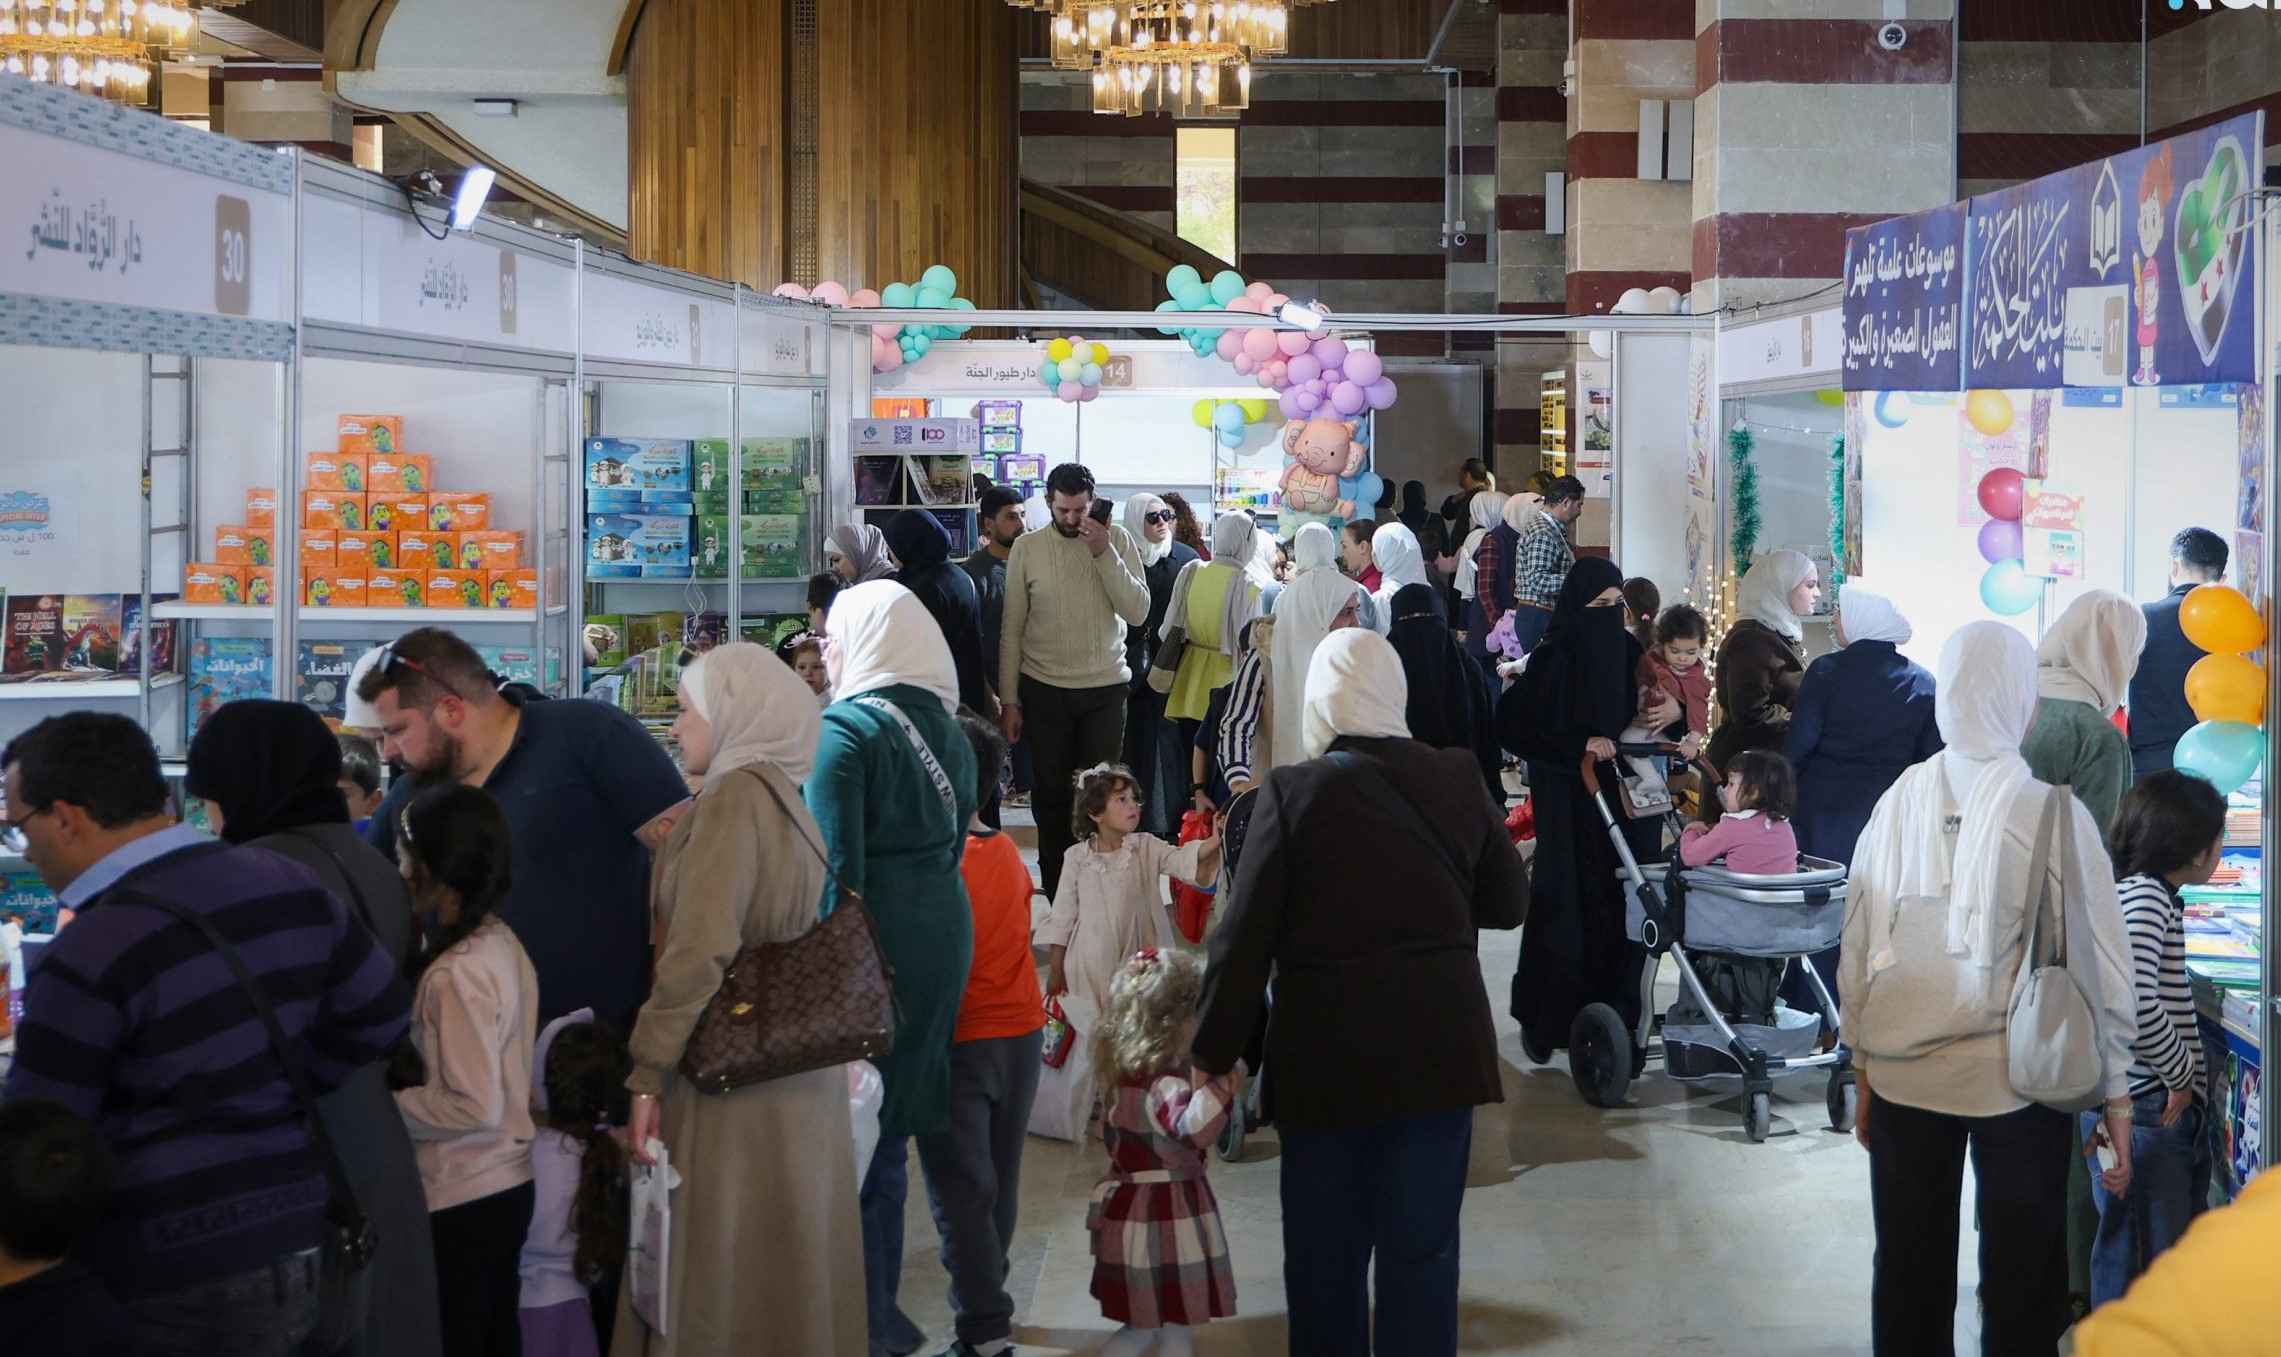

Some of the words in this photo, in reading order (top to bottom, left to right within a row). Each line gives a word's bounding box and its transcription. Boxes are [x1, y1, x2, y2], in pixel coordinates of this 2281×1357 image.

[119, 219, 142, 275] دار
[222, 229, 244, 283] 30
[1849, 243, 1876, 297] تلهم
[1876, 237, 1902, 297] علمية
[1904, 232, 1956, 291] موسوعات
[502, 274, 513, 311] 30
[1841, 310, 1878, 371] والكبيرة
[1880, 307, 1920, 369] الصغيرة
[1921, 303, 1957, 368] العقول
[2109, 318, 2120, 354] 17
[993, 366, 1020, 381] طيور
[1019, 366, 1036, 381] دار
[1106, 364, 1126, 379] 14
[206, 658, 264, 674] الحيوانات
[915, 740, 943, 786] STYLE
